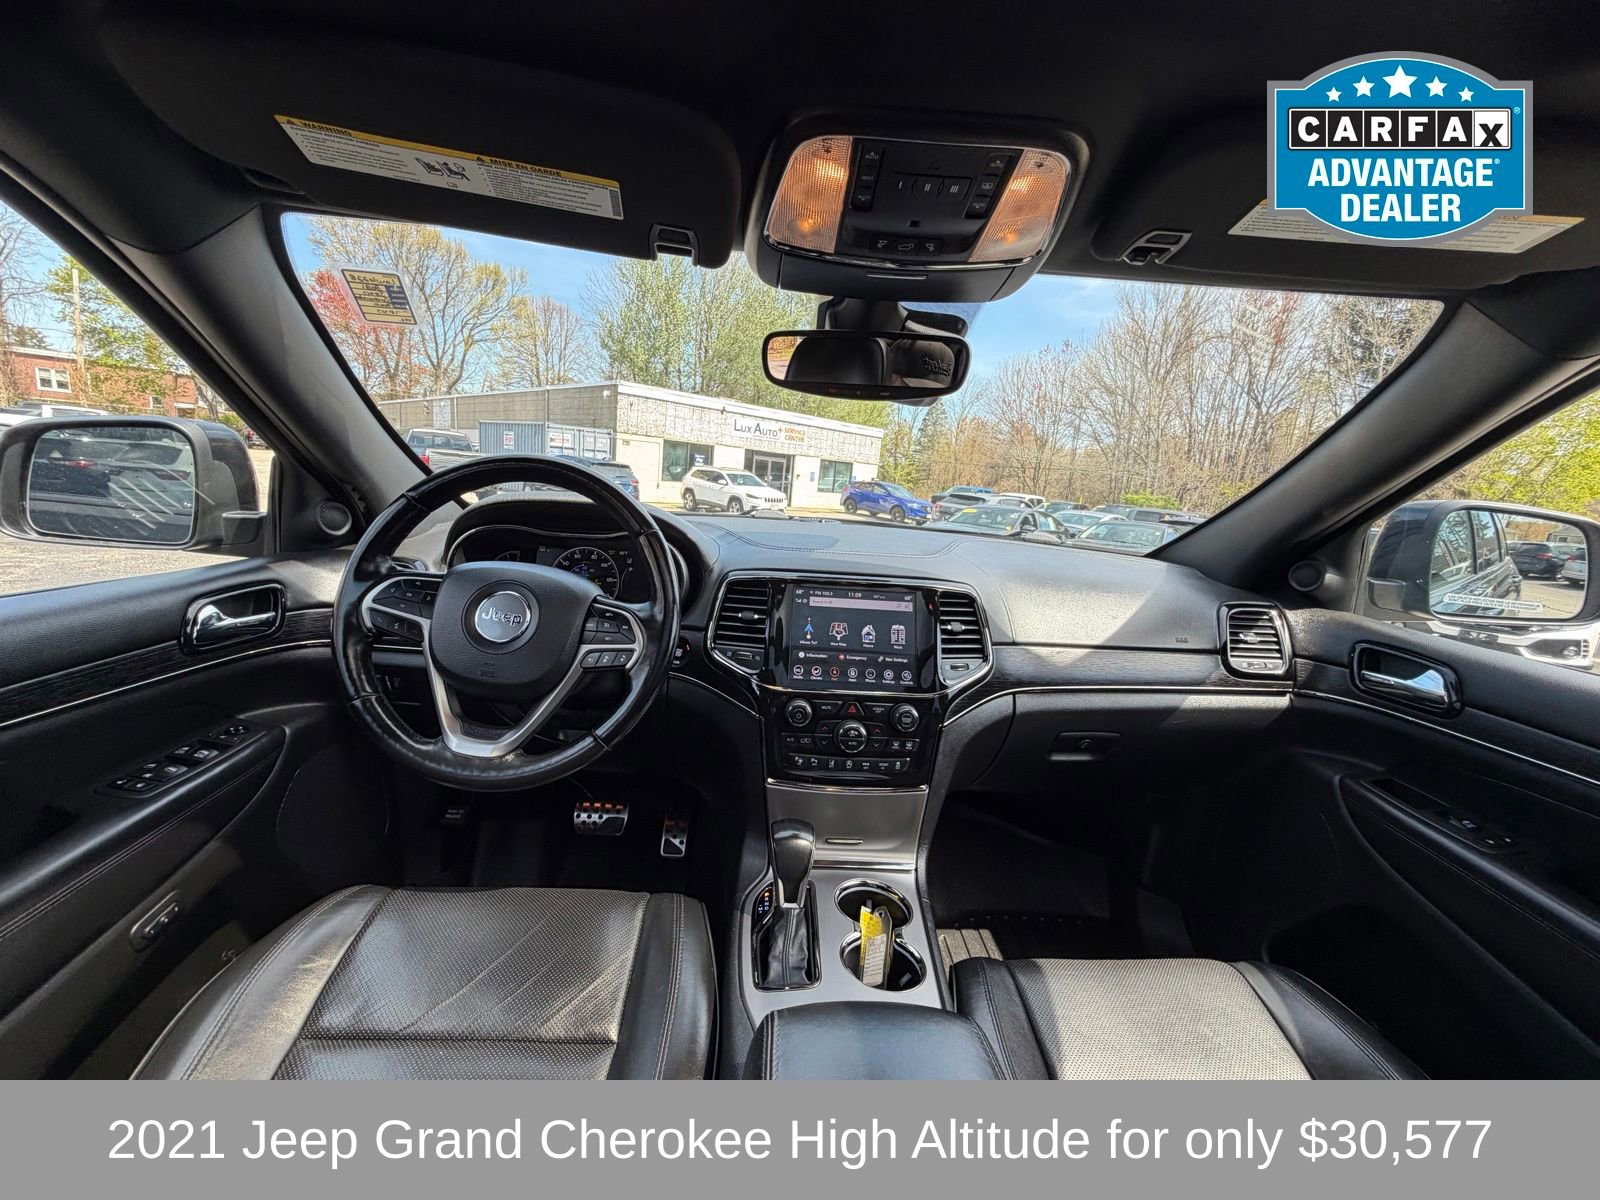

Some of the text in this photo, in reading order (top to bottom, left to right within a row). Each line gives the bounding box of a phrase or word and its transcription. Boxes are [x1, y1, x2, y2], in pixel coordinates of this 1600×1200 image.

[300, 121, 353, 137] WARNING
[489, 158, 562, 178] MISE EN GARDE
[784, 427, 806, 437] SERVICE
[784, 434, 805, 443] CENTER
[481, 607, 523, 627] Jeep
